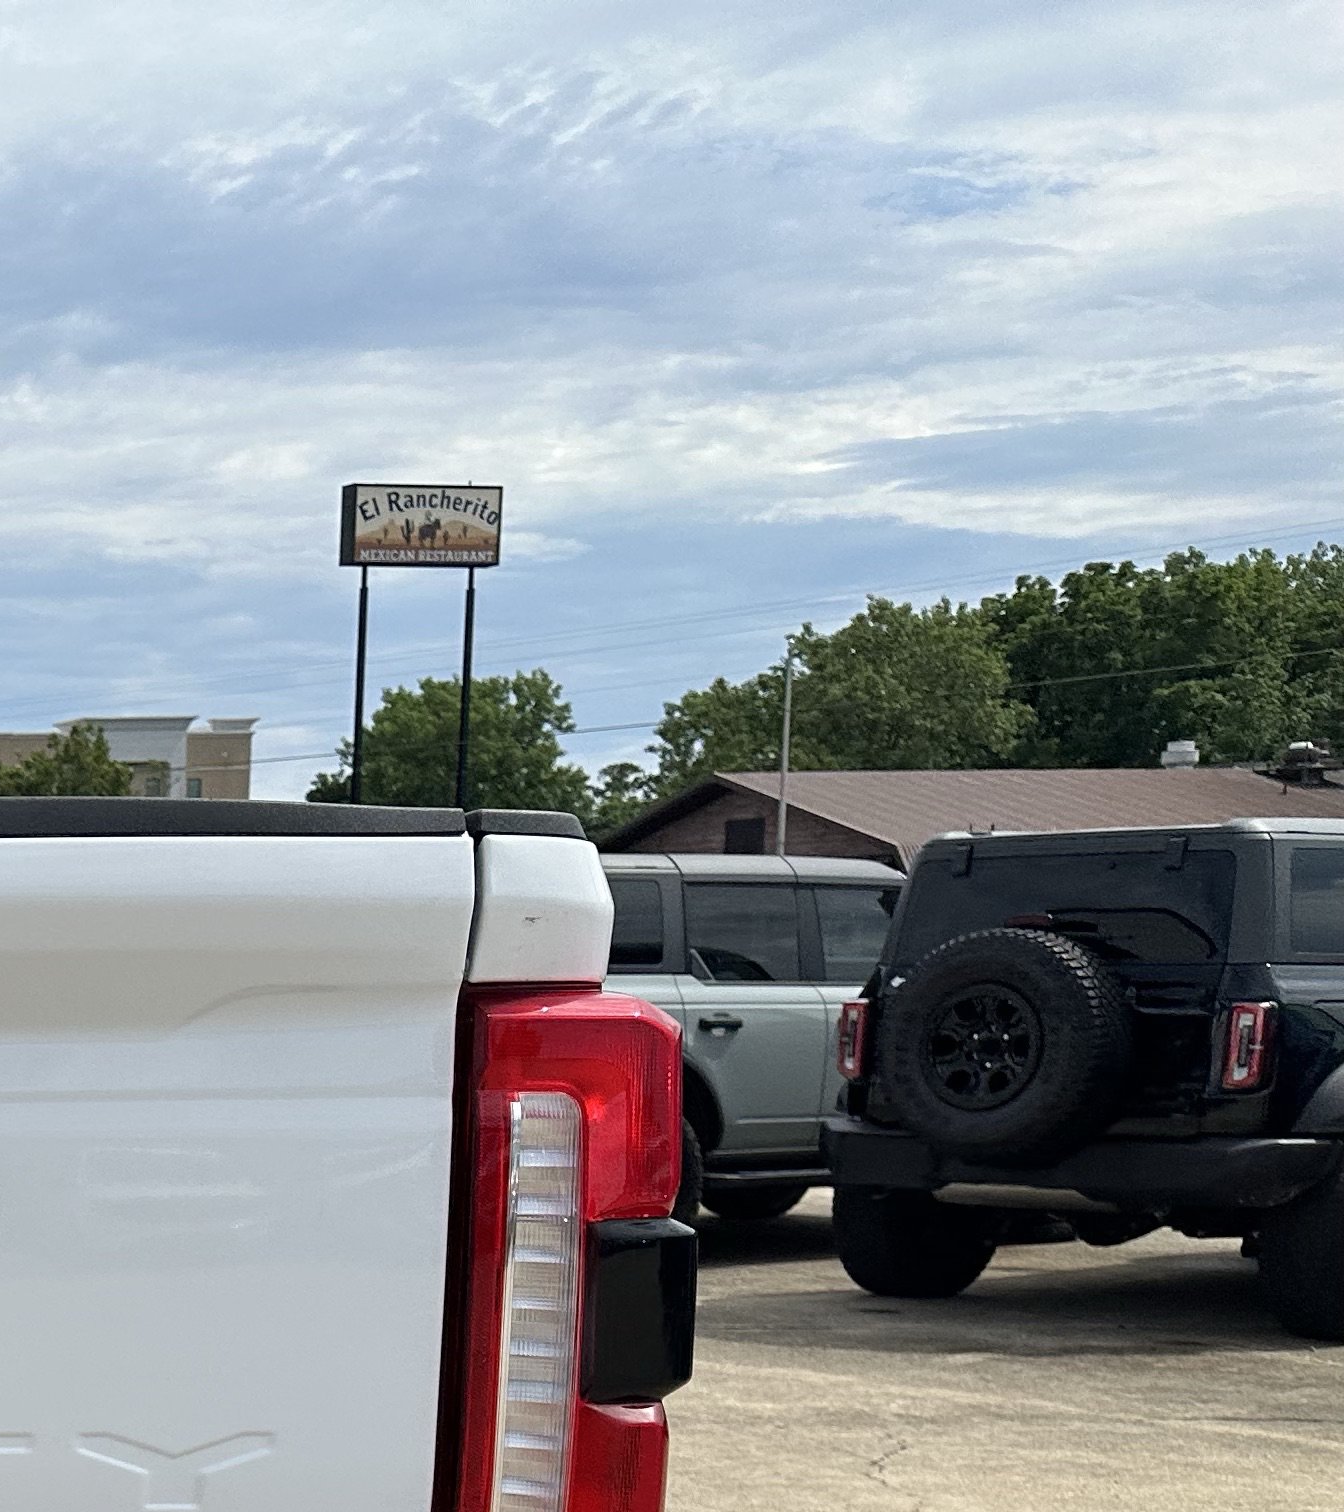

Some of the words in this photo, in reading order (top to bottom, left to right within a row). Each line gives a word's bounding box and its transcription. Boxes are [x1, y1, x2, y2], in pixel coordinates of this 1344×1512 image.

[358, 498, 380, 521] El
[387, 490, 499, 526] Rancherito
[360, 550, 415, 562] MEXICAN
[418, 550, 494, 562] RESTAURANT
